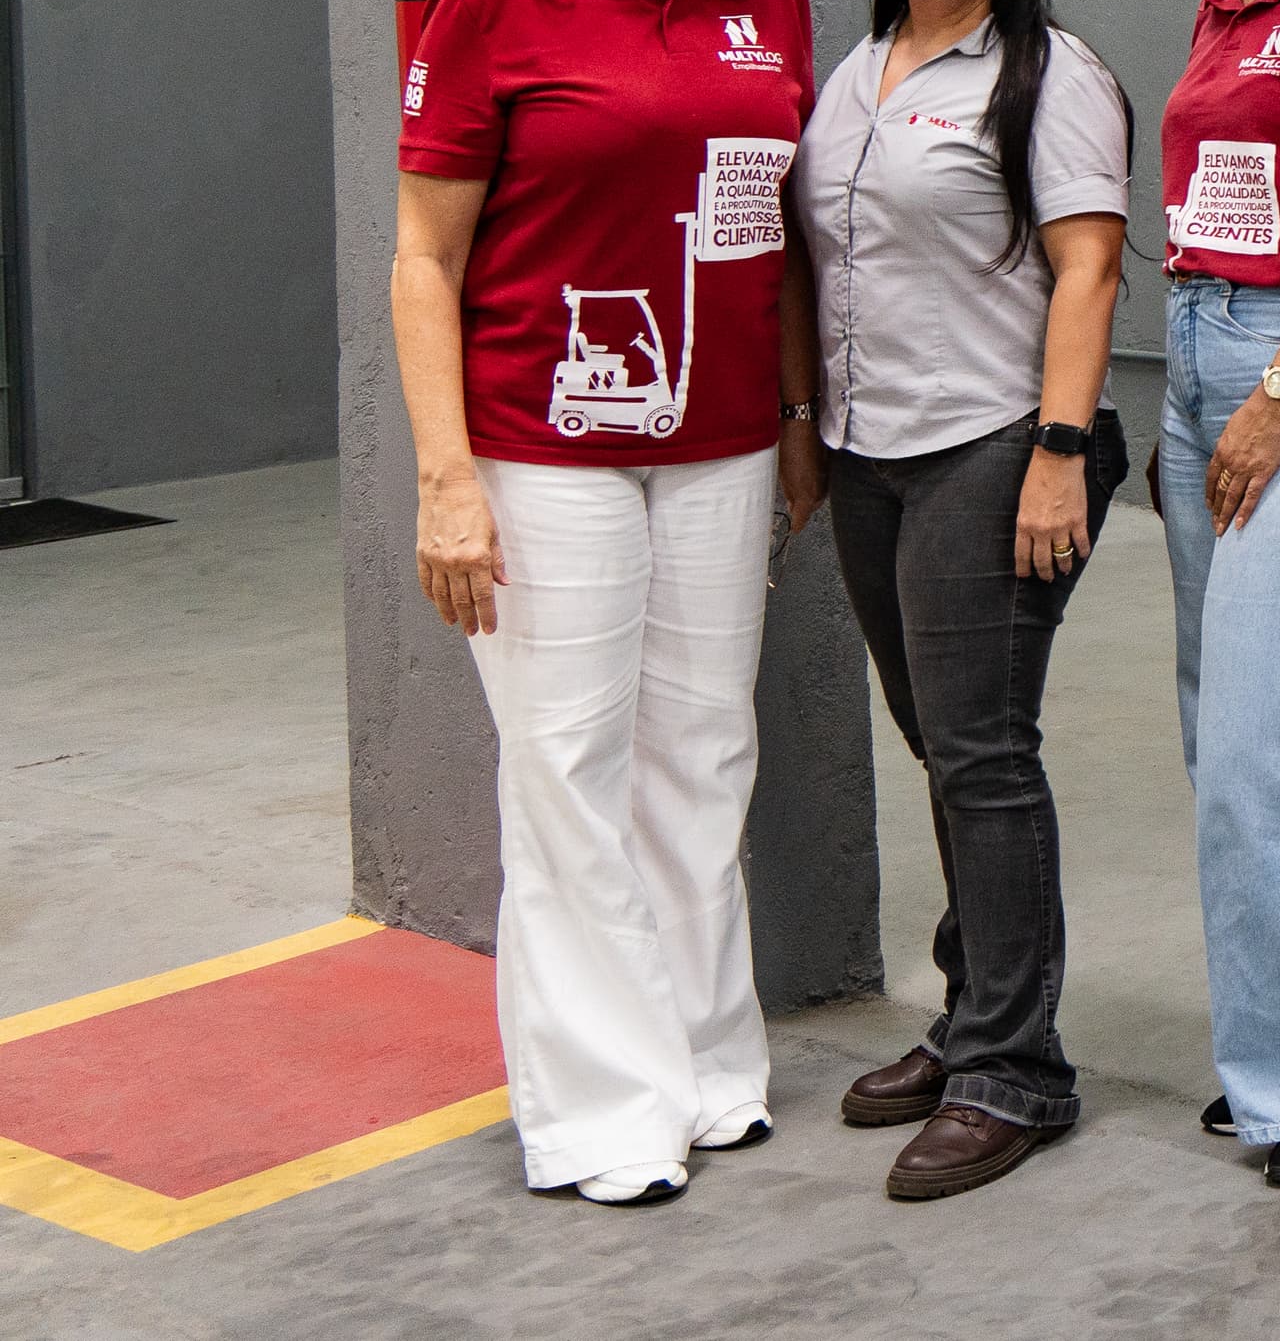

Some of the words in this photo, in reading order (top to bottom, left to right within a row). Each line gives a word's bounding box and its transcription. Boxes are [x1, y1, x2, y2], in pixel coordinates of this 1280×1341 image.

[718, 50, 783, 64] MULTYLOG
[1204, 154, 1265, 170] ELEVAMOS
[716, 170, 738, 183] AO
[1202, 172, 1219, 184] AO
[1220, 168, 1267, 186] MÁXIMO
[715, 185, 725, 198] A
[1200, 187, 1208, 198] A
[1209, 187, 1271, 200] QUALIDADE
[714, 202, 719, 211] E
[720, 202, 727, 211] A
[1198, 201, 1203, 209] E
[1203, 201, 1209, 209] A
[1210, 201, 1272, 212] PRODUTIVIDADE
[714, 213, 740, 226] NOS
[1193, 212, 1219, 224] NOS
[1221, 212, 1273, 225] NOSSOS
[713, 226, 783, 247] CLIENTES
[1186, 223, 1273, 244] CLIENTES
